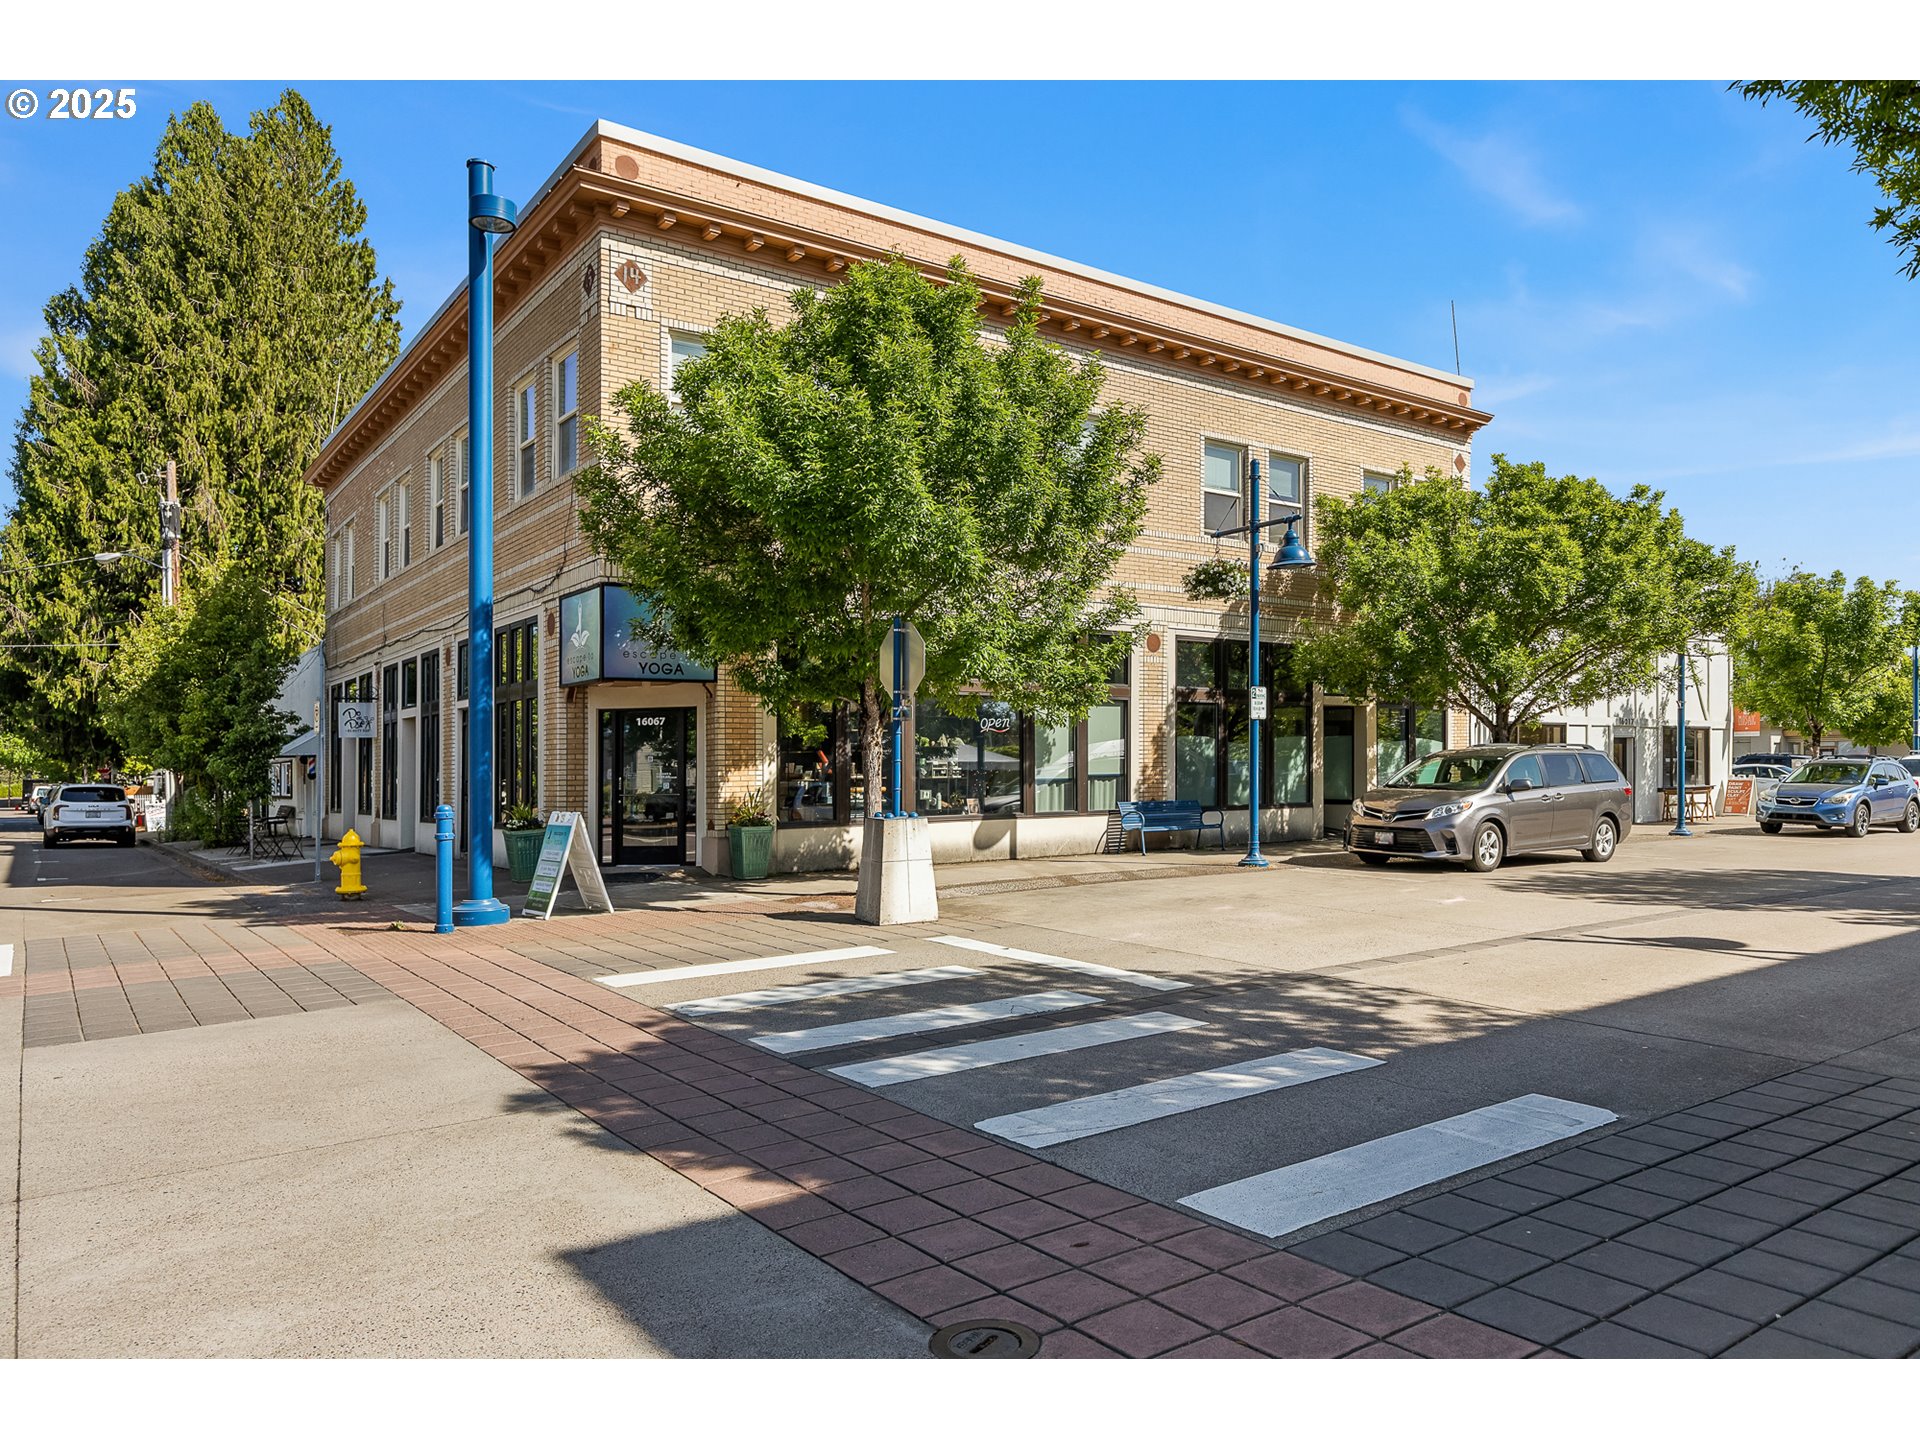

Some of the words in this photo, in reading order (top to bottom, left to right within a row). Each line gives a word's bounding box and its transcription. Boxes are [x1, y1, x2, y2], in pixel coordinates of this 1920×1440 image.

[571, 665, 590, 679] YOGA
[638, 662, 685, 675] YOGA
[636, 717, 666, 726] 16067
